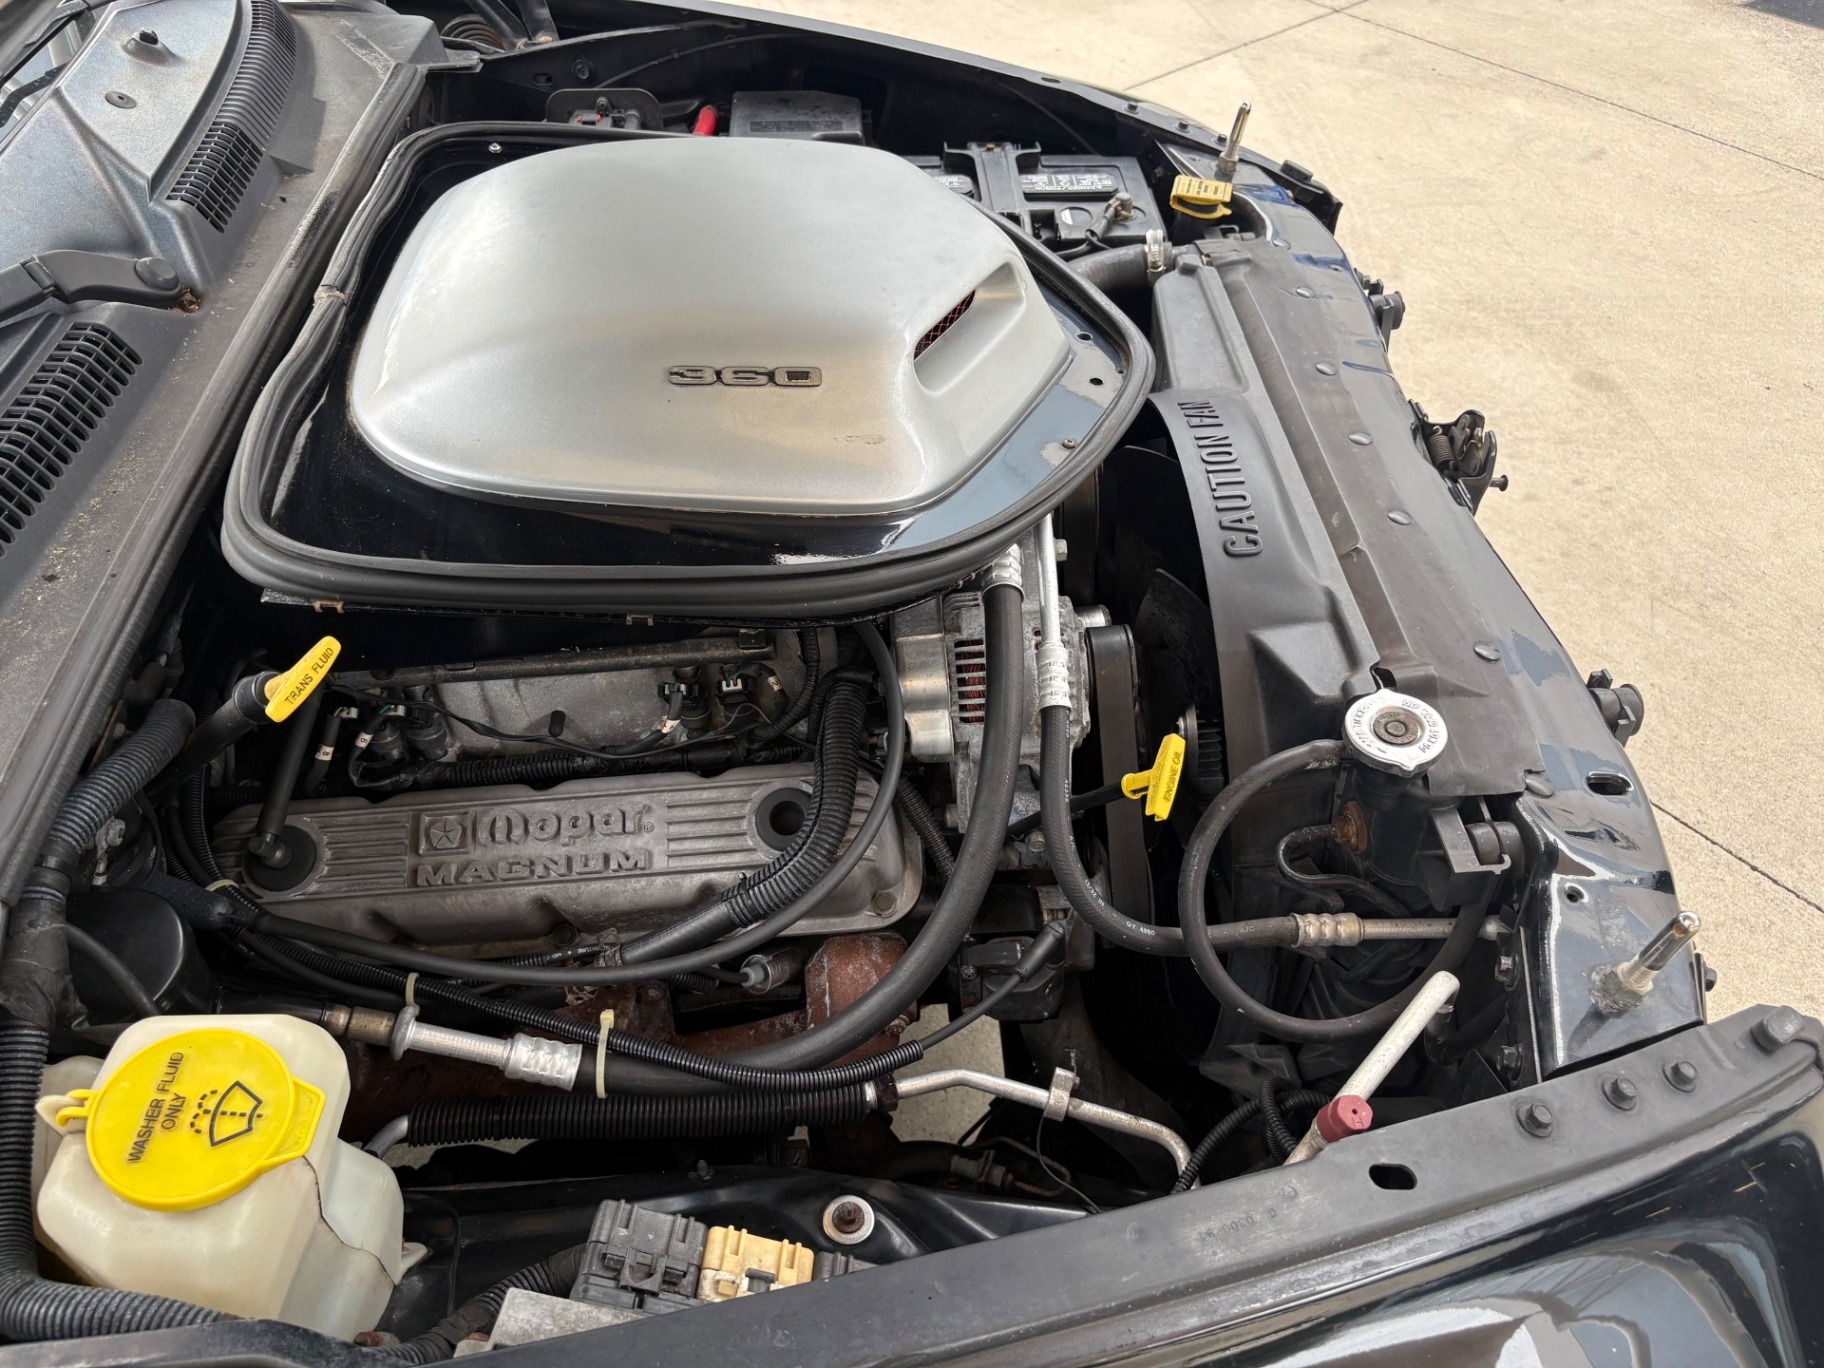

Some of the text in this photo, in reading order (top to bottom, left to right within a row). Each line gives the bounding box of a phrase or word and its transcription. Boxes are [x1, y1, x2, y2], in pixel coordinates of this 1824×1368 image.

[668, 365, 822, 387] 360
[1177, 401, 1263, 558] CAUTION FAN
[284, 647, 334, 704] TRANS FLUID
[1162, 751, 1183, 802] ENGINE OIL
[417, 850, 652, 887] MAGNUM
[127, 1052, 185, 1164] WASHER FLUID
[161, 1092, 187, 1130] ONLY
